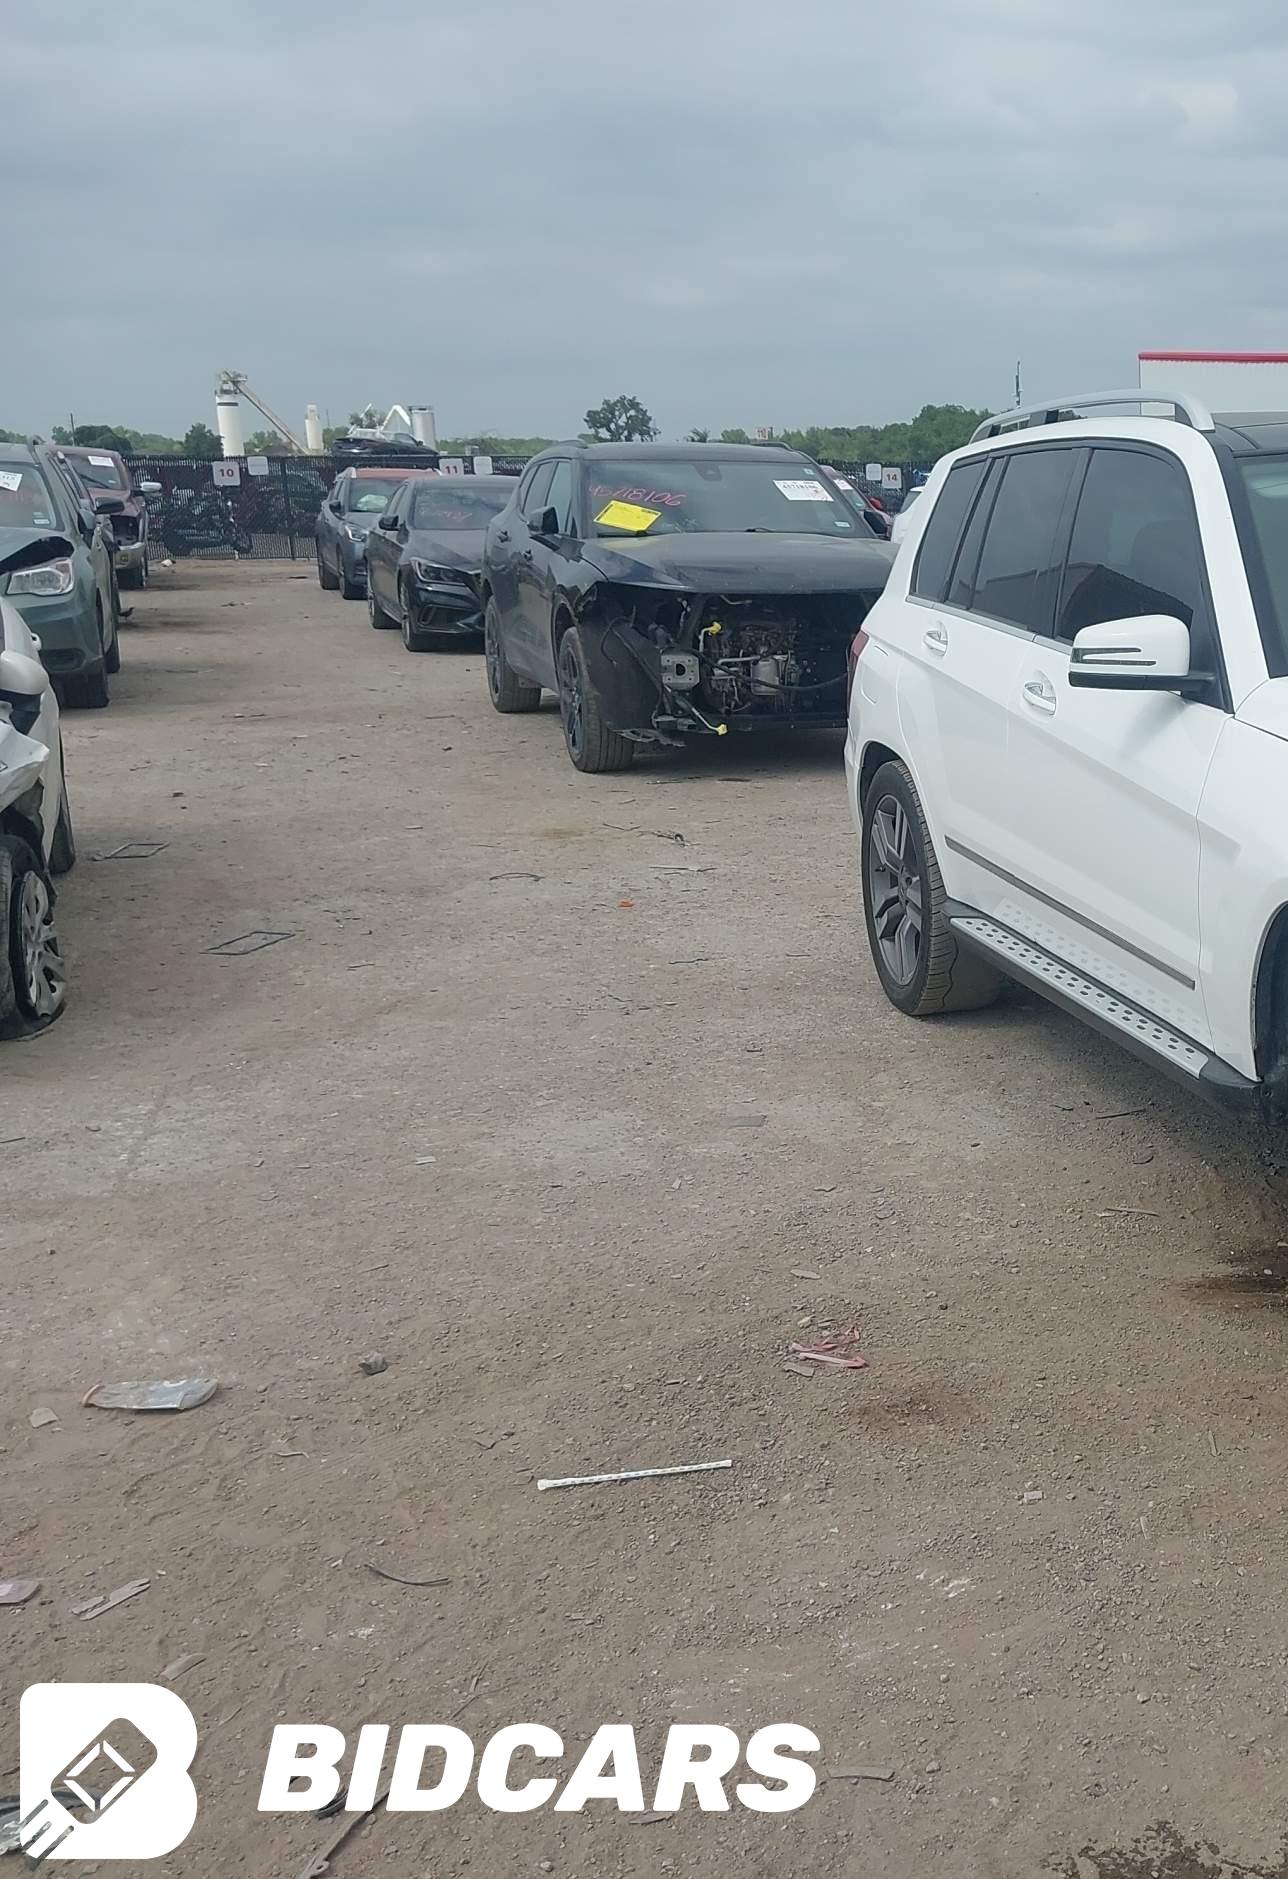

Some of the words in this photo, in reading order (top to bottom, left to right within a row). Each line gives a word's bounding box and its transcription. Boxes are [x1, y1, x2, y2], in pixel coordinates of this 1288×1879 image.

[220, 468, 234, 477] 10
[445, 465, 458, 474] 11
[886, 473, 897, 481] 14
